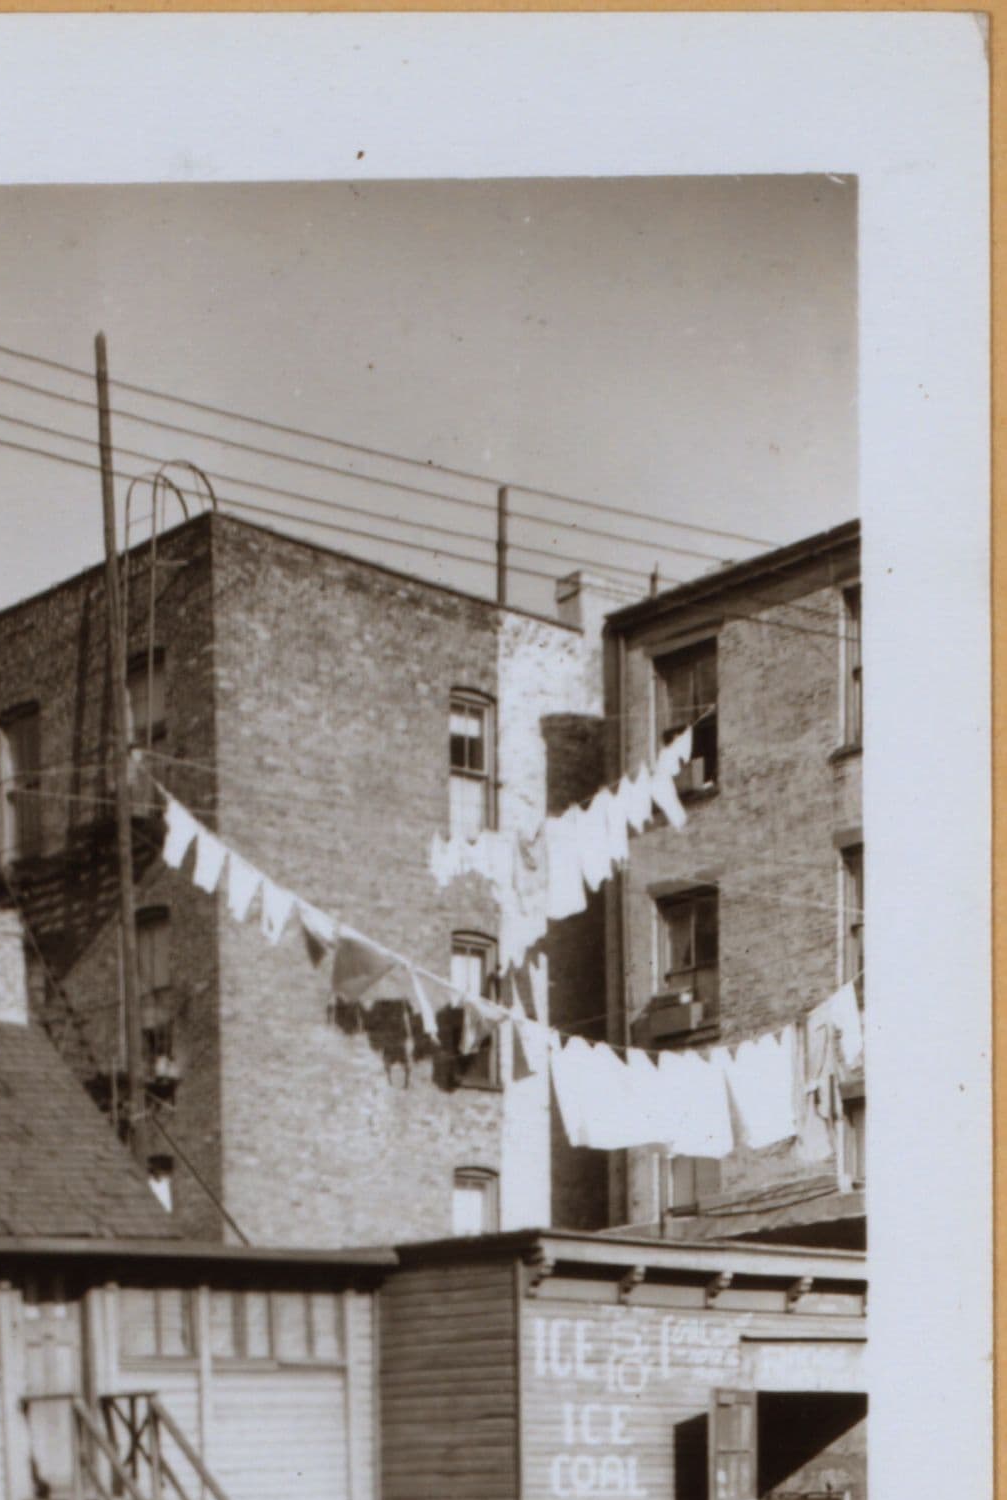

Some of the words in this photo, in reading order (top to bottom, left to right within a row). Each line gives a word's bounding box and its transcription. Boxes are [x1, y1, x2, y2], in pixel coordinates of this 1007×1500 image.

[535, 1318, 596, 1377] ICE
[564, 1403, 634, 1444] ICE
[550, 1453, 648, 1498] COAL
